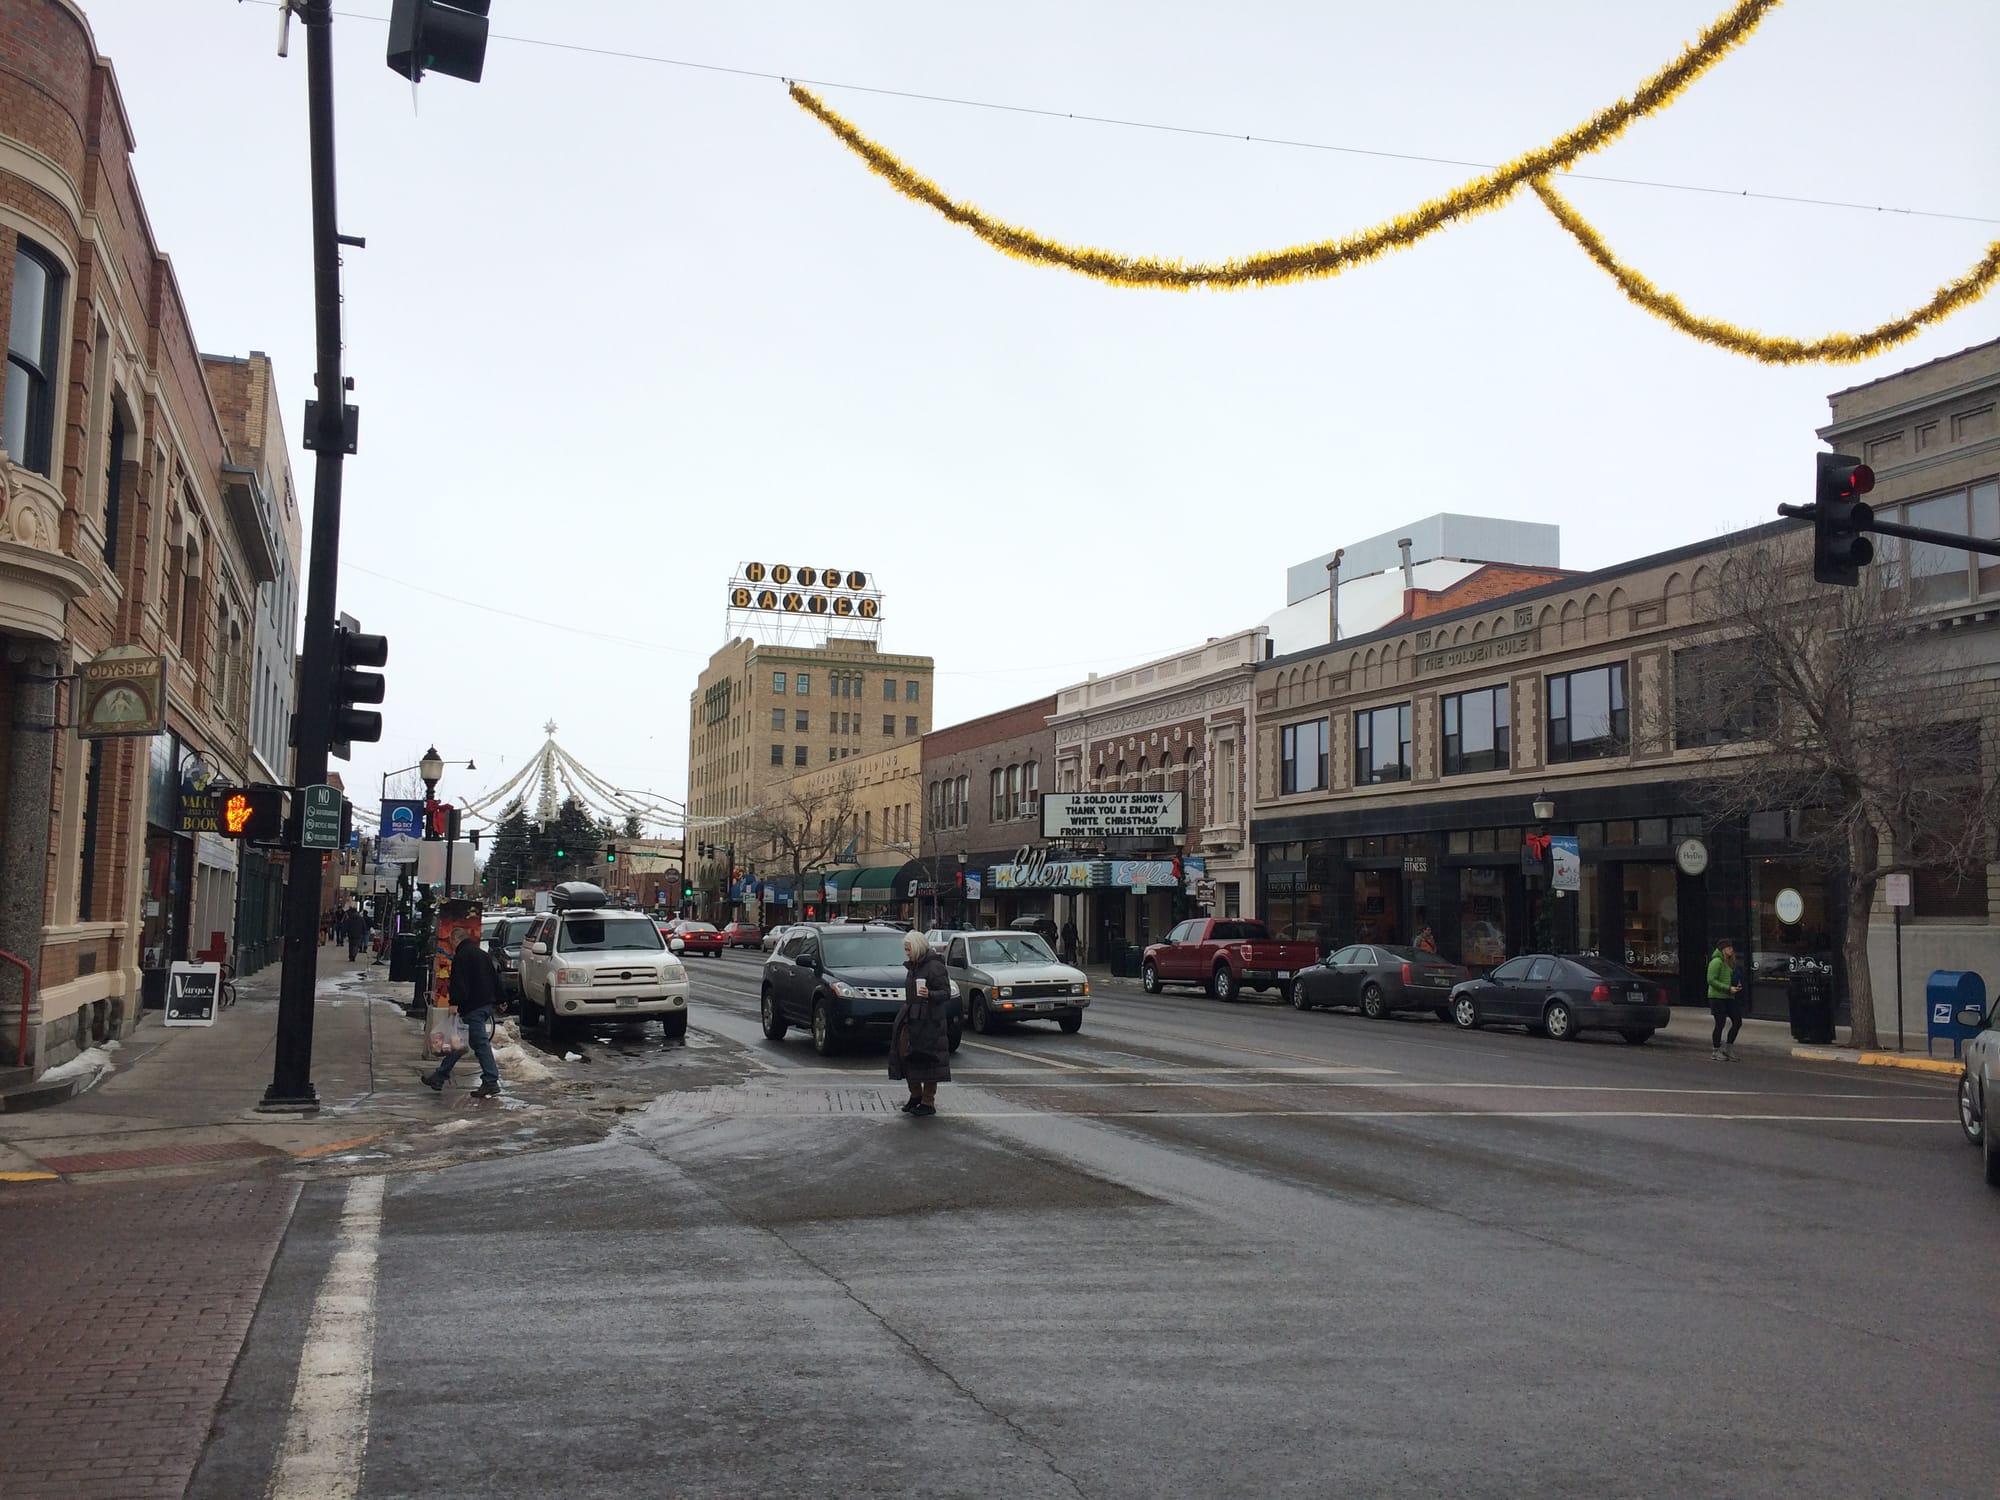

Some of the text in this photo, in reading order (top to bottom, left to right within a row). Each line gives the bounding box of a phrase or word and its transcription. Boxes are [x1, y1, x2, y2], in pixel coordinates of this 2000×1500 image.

[748, 562, 864, 590] HOTEL
[734, 588, 876, 618] BAXTER
[1423, 637, 1528, 671] THE GOLDEN RULE
[89, 661, 152, 678] ODYSSEY
[318, 789, 330, 804] NO
[1071, 794, 1164, 805] 12 SOLD OUT SHOWS
[1065, 805, 1168, 815] THANK YOU & ENJOY A
[1070, 816, 1158, 825] WHITE CHRISTMAS
[1060, 827, 1085, 836] FROM
[1087, 827, 1105, 836] THE
[1136, 826, 1177, 836] THEATRE
[1012, 844, 1070, 887] Ellen
[1404, 862, 1427, 872] FITNESS
[174, 975, 213, 998] Vargo's
